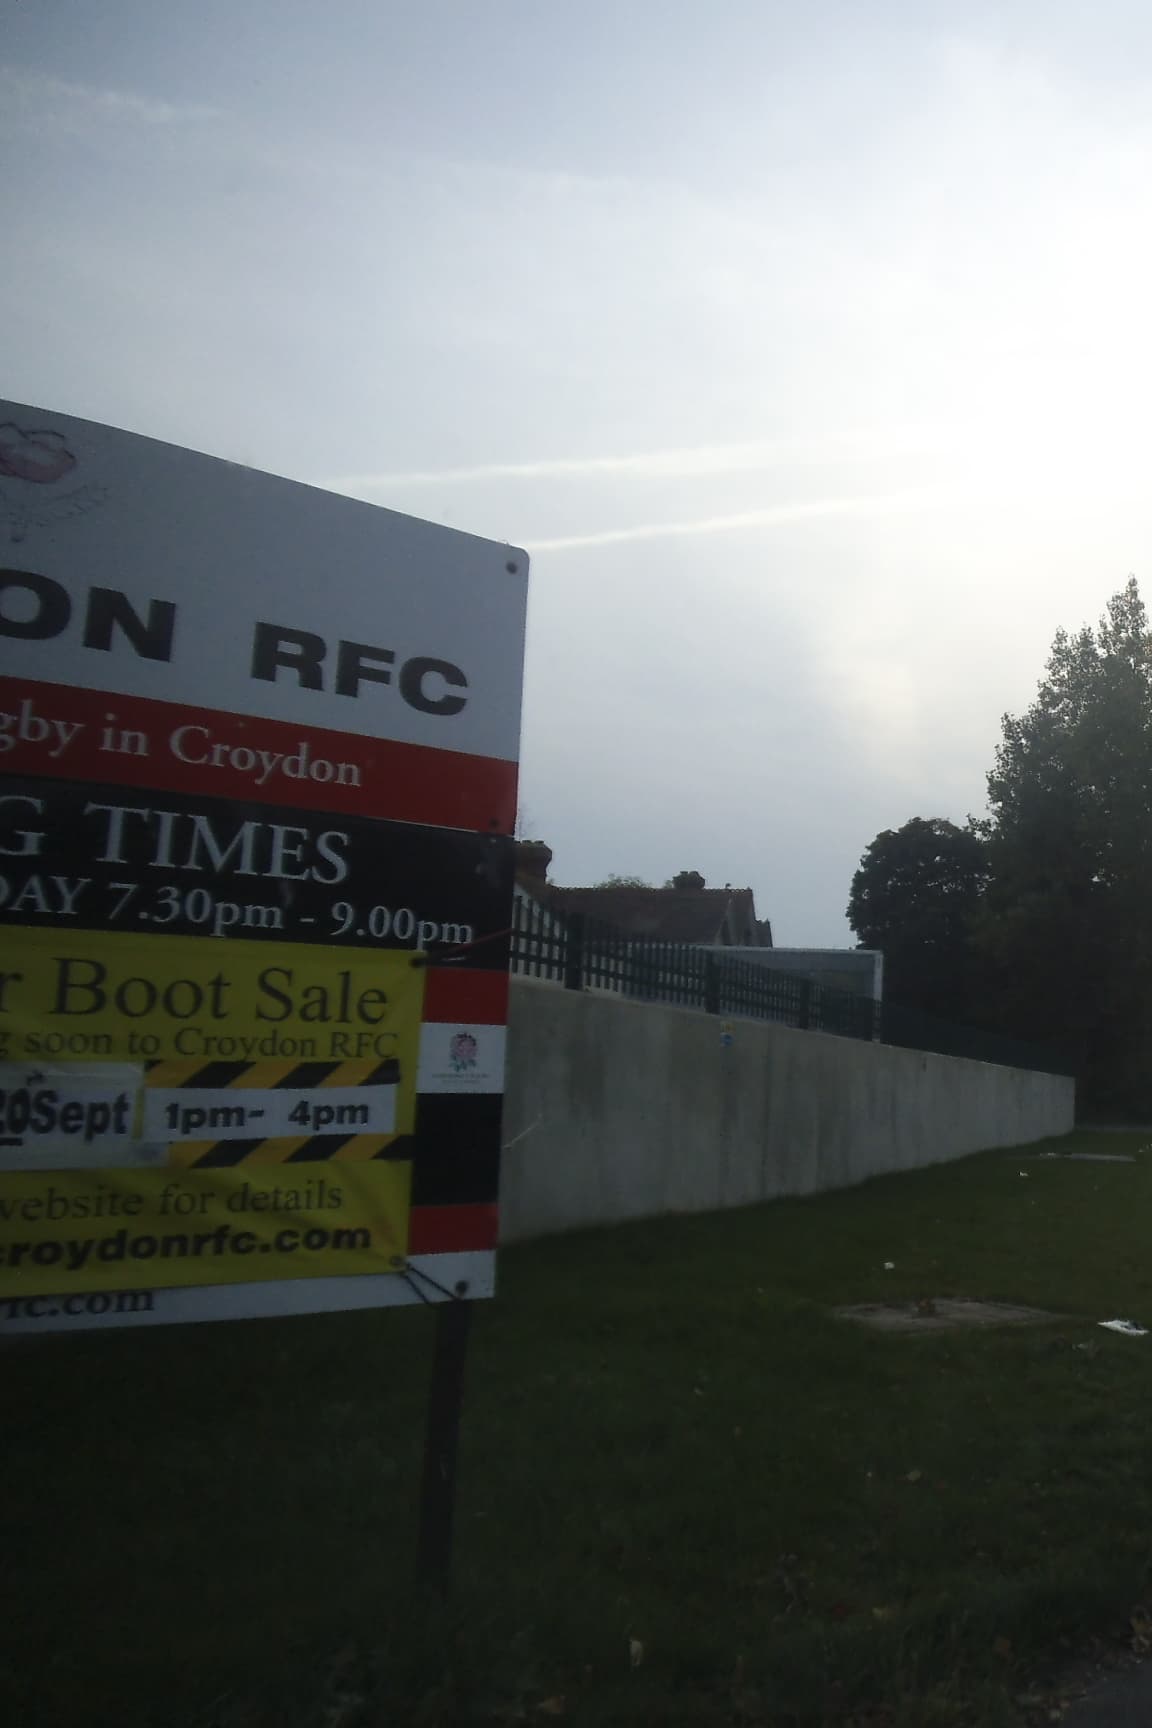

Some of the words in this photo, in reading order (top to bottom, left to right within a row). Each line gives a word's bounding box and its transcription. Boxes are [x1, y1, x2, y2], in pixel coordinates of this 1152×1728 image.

[250, 622, 469, 717] RFC
[99, 713, 150, 757] in
[169, 725, 362, 787] Croydon
[83, 801, 351, 885] TIMES
[0, 872, 92, 915] AY
[104, 882, 284, 938] 7.30pm
[329, 901, 473, 953] 9.00pm
[48, 957, 231, 1021] Boot
[254, 967, 388, 1025] Sale
[24, 1031, 112, 1055] soon
[128, 1030, 157, 1056] to
[174, 1027, 317, 1062] Croydon
[330, 1031, 399, 1059] RFC
[0, 1087, 129, 1142] 0Sept
[287, 1099, 370, 1131] 4pm
[159, 1184, 211, 1215] for
[226, 1179, 343, 1213] details
[0, 1222, 371, 1271] roydonrfc.com
